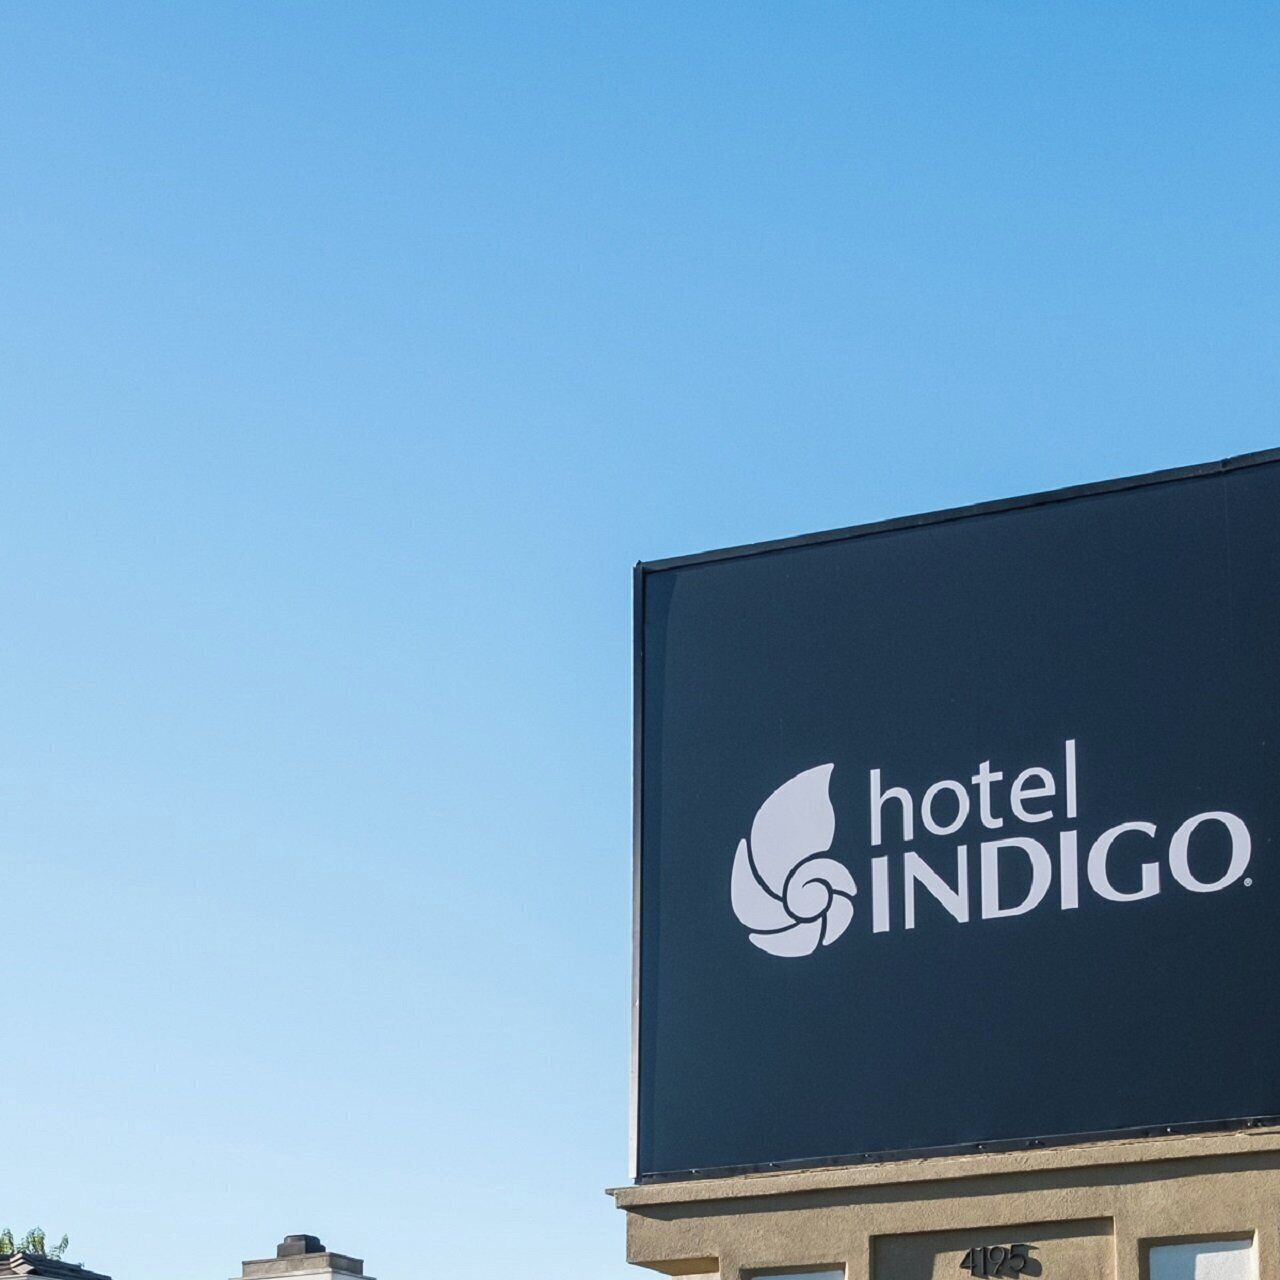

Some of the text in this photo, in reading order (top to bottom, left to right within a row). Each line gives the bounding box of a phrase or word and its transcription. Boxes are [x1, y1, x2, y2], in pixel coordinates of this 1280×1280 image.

[870, 738, 1078, 846] hotel
[870, 810, 1253, 934] INDIGO
[959, 1243, 1029, 1278] 4195
